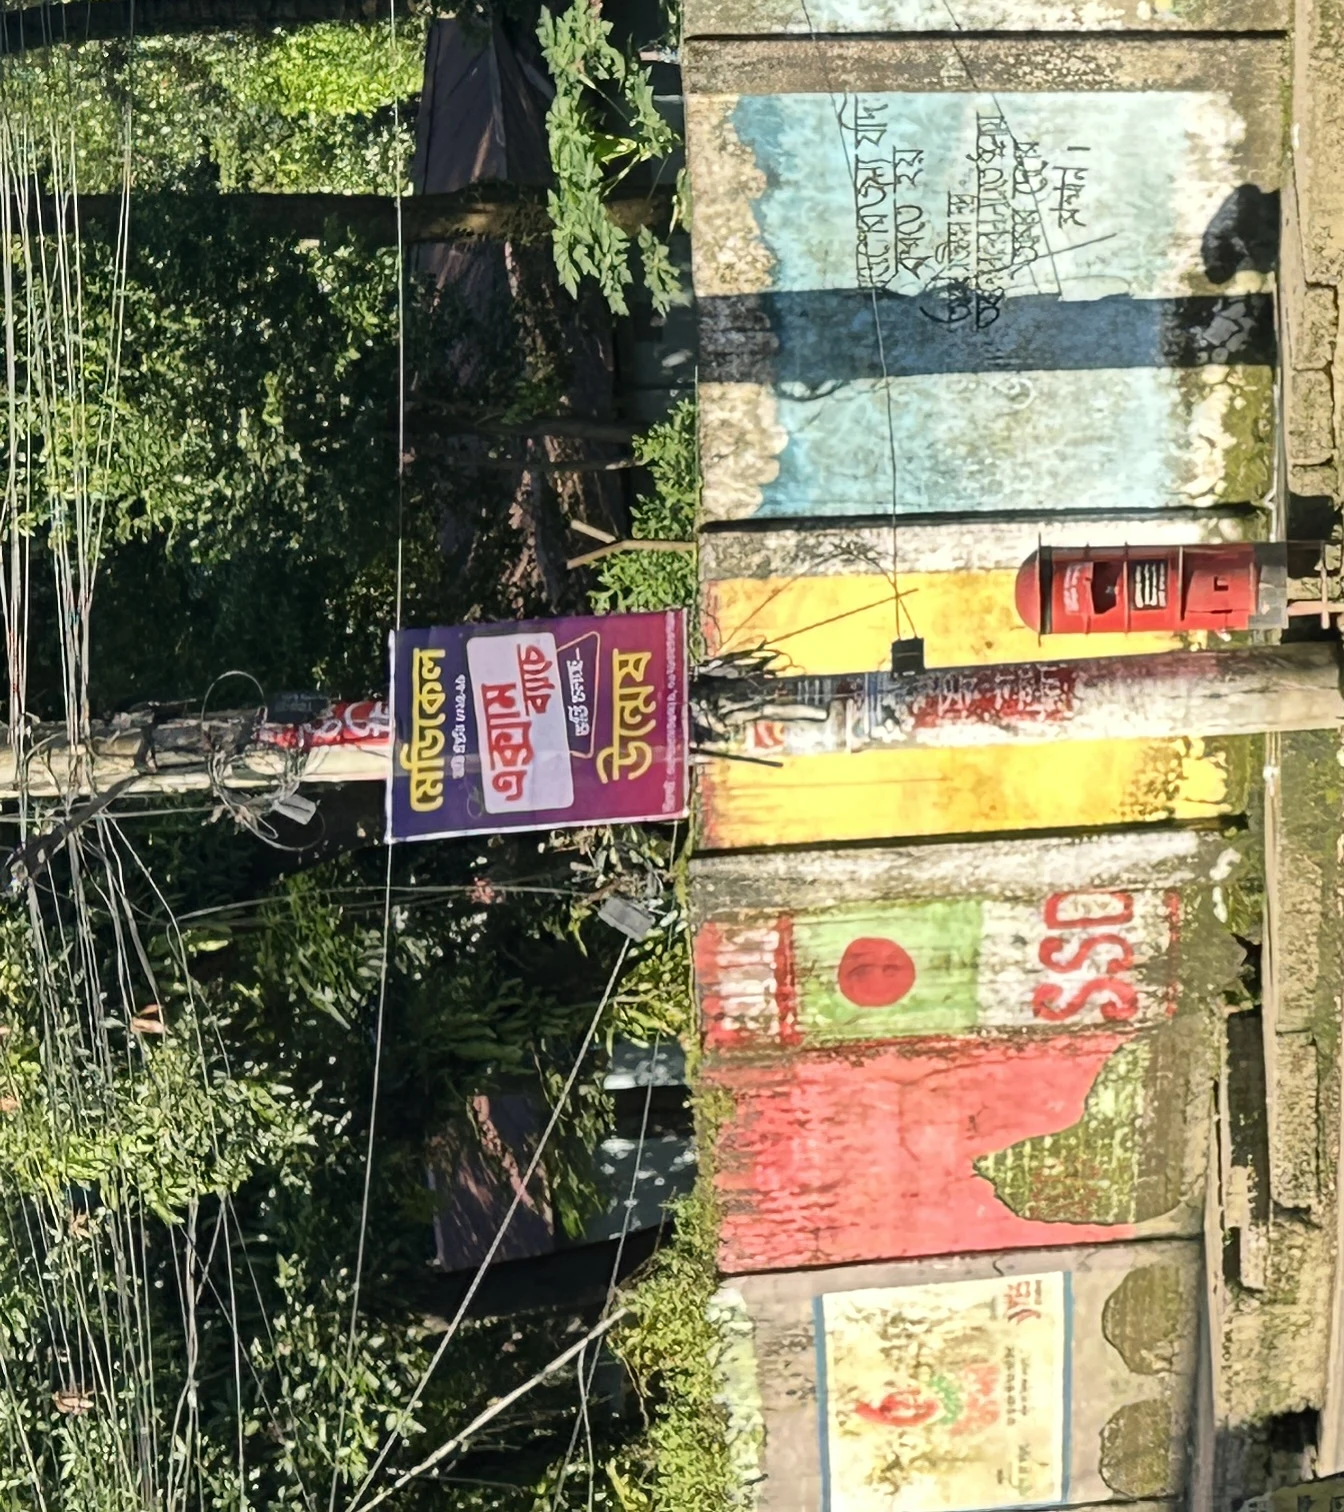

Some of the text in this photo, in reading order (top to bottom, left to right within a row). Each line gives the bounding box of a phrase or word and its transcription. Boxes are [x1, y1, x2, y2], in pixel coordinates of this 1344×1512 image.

[399, 647, 447, 812] মেডিকেল
[481, 683, 533, 802] এক্সাম
[517, 644, 555, 717] ব্যাচে
[596, 648, 657, 784] উন্মেষ
[1032, 890, 1139, 1022] SSD
